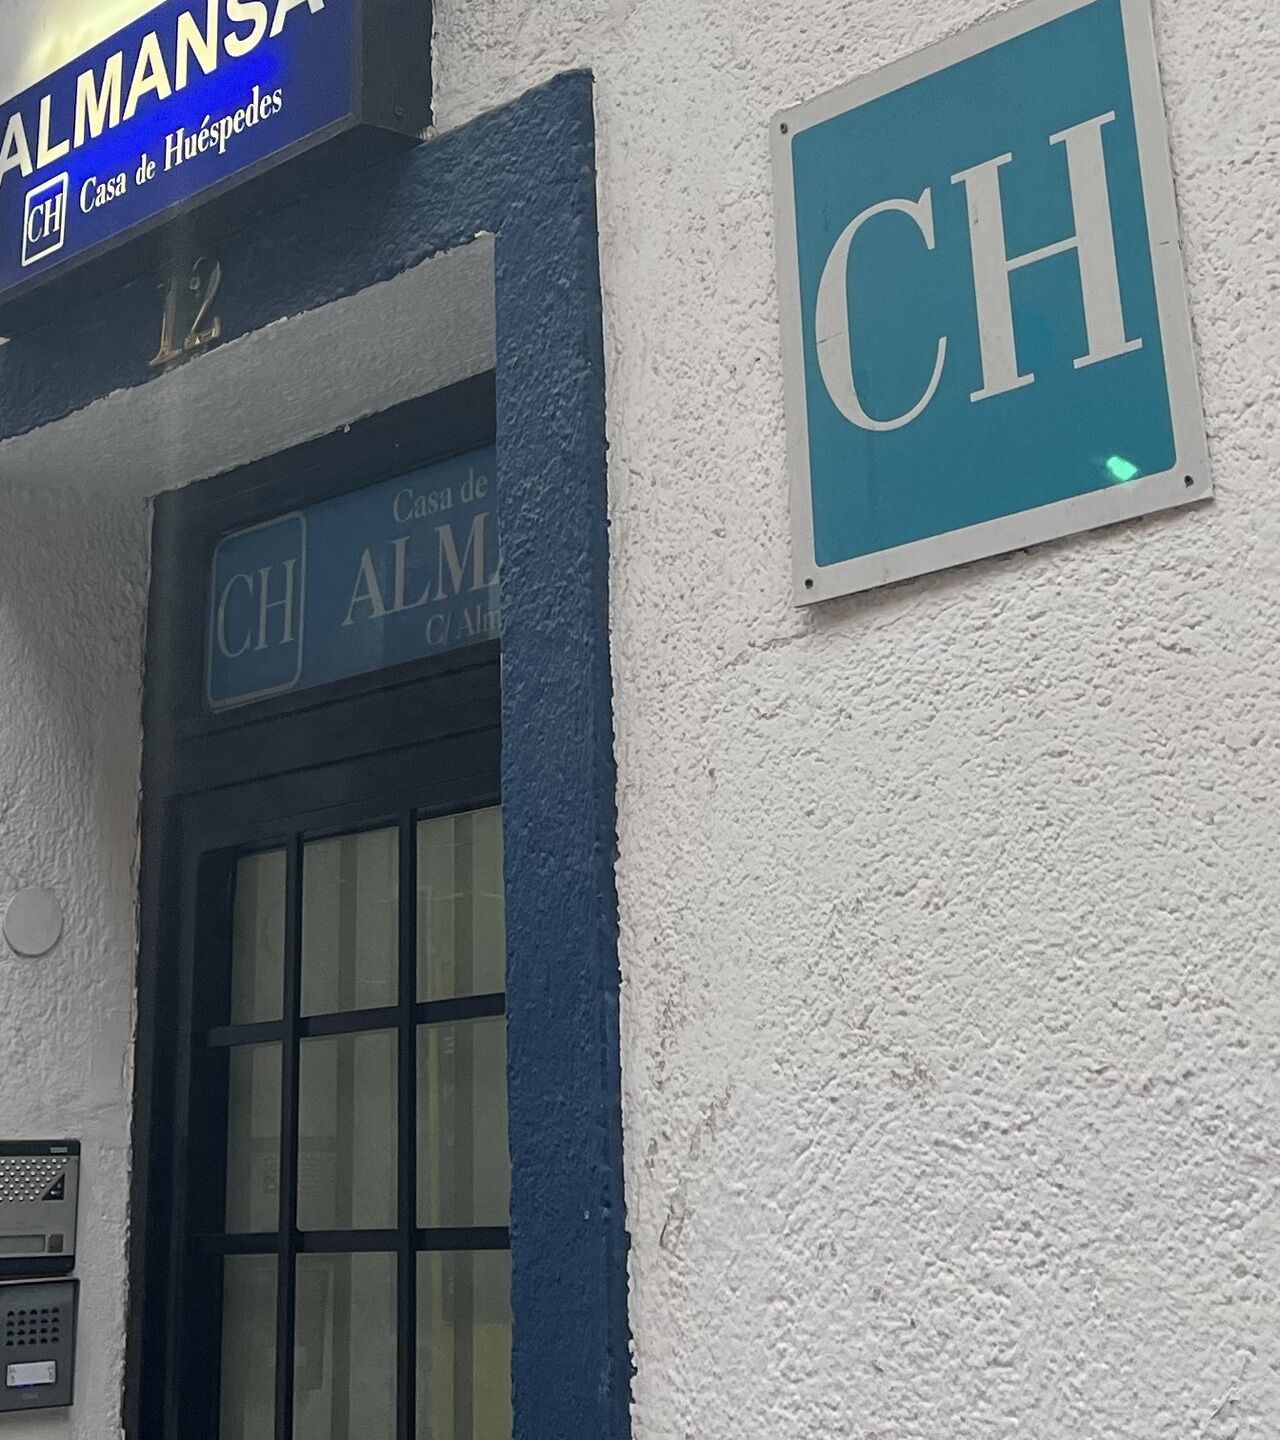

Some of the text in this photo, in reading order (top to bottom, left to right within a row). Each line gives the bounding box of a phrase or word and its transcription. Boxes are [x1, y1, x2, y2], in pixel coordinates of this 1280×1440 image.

[26, 84, 284, 244] CH Casa de Huéspedes
[147, 256, 223, 367] 12
[814, 109, 1144, 432] CH
[392, 466, 489, 524] Casa de
[217, 557, 300, 659] CH
[340, 510, 501, 628] ALM
